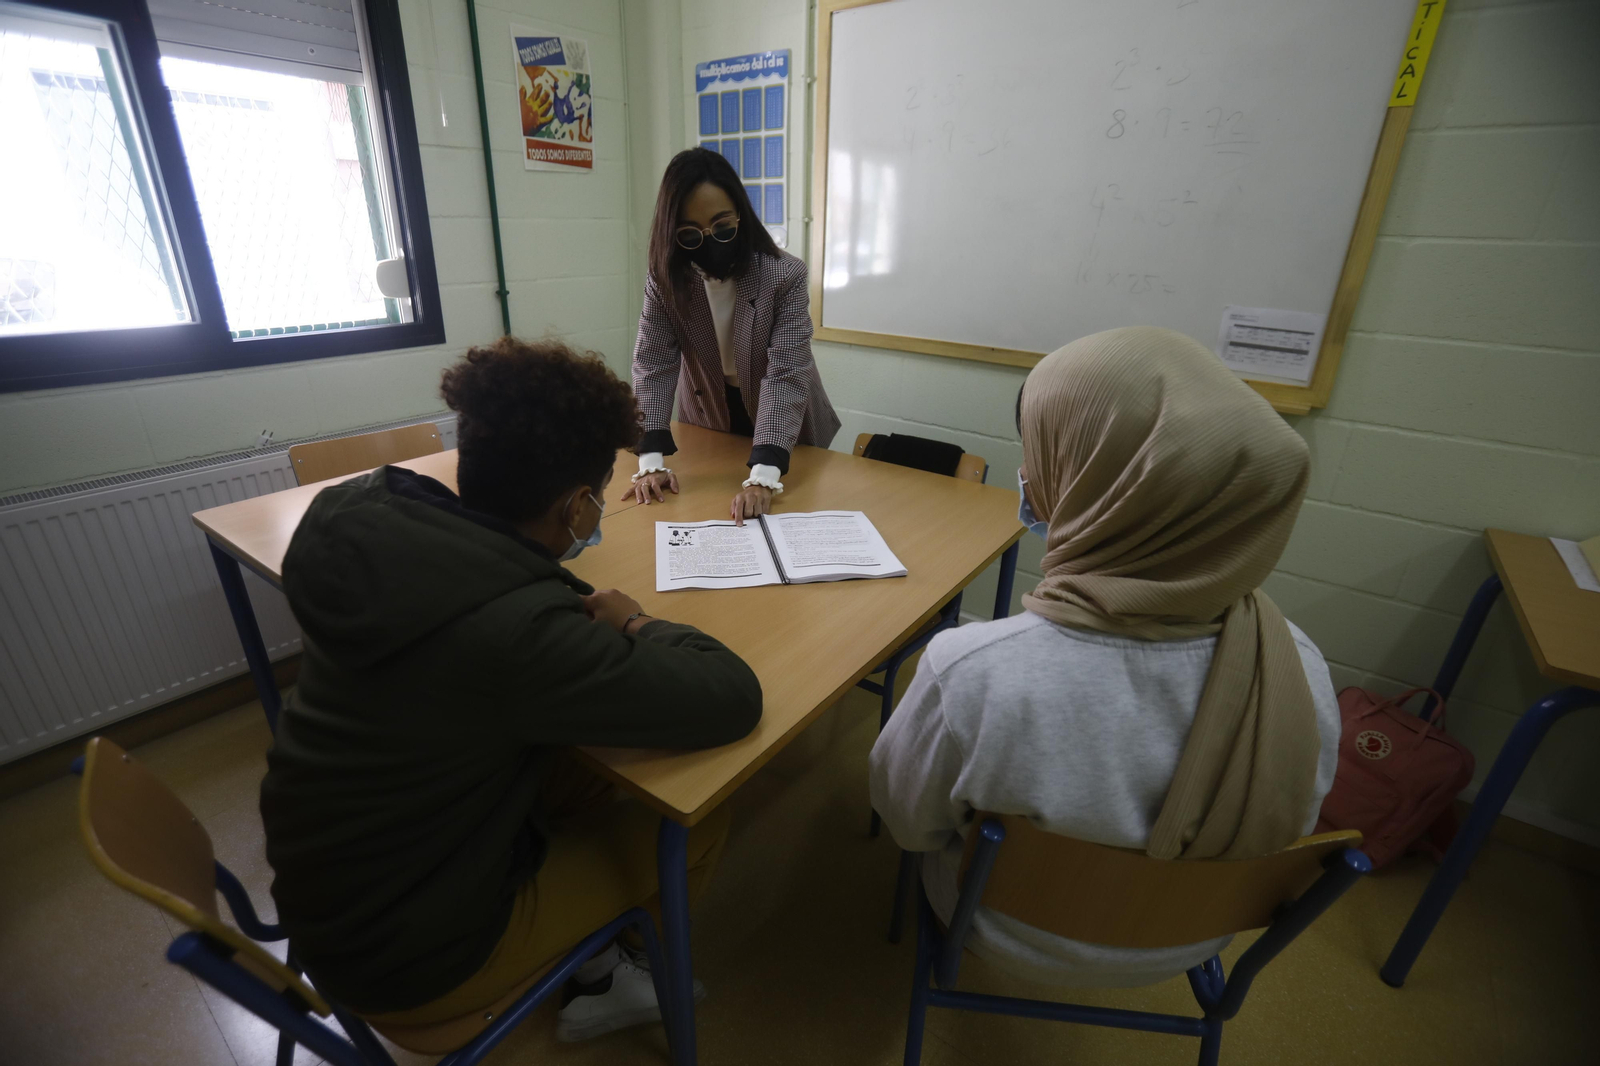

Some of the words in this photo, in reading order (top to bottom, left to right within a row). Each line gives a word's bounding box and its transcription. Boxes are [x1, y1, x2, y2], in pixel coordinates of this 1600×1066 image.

[519, 46, 536, 64] TODOS
[532, 42, 548, 61] SOMOS
[700, 61, 750, 78] multiplicamos
[528, 148, 547, 160] TODOS
[547, 149, 565, 161] SOMOS
[565, 149, 592, 162] DIFERENTES
